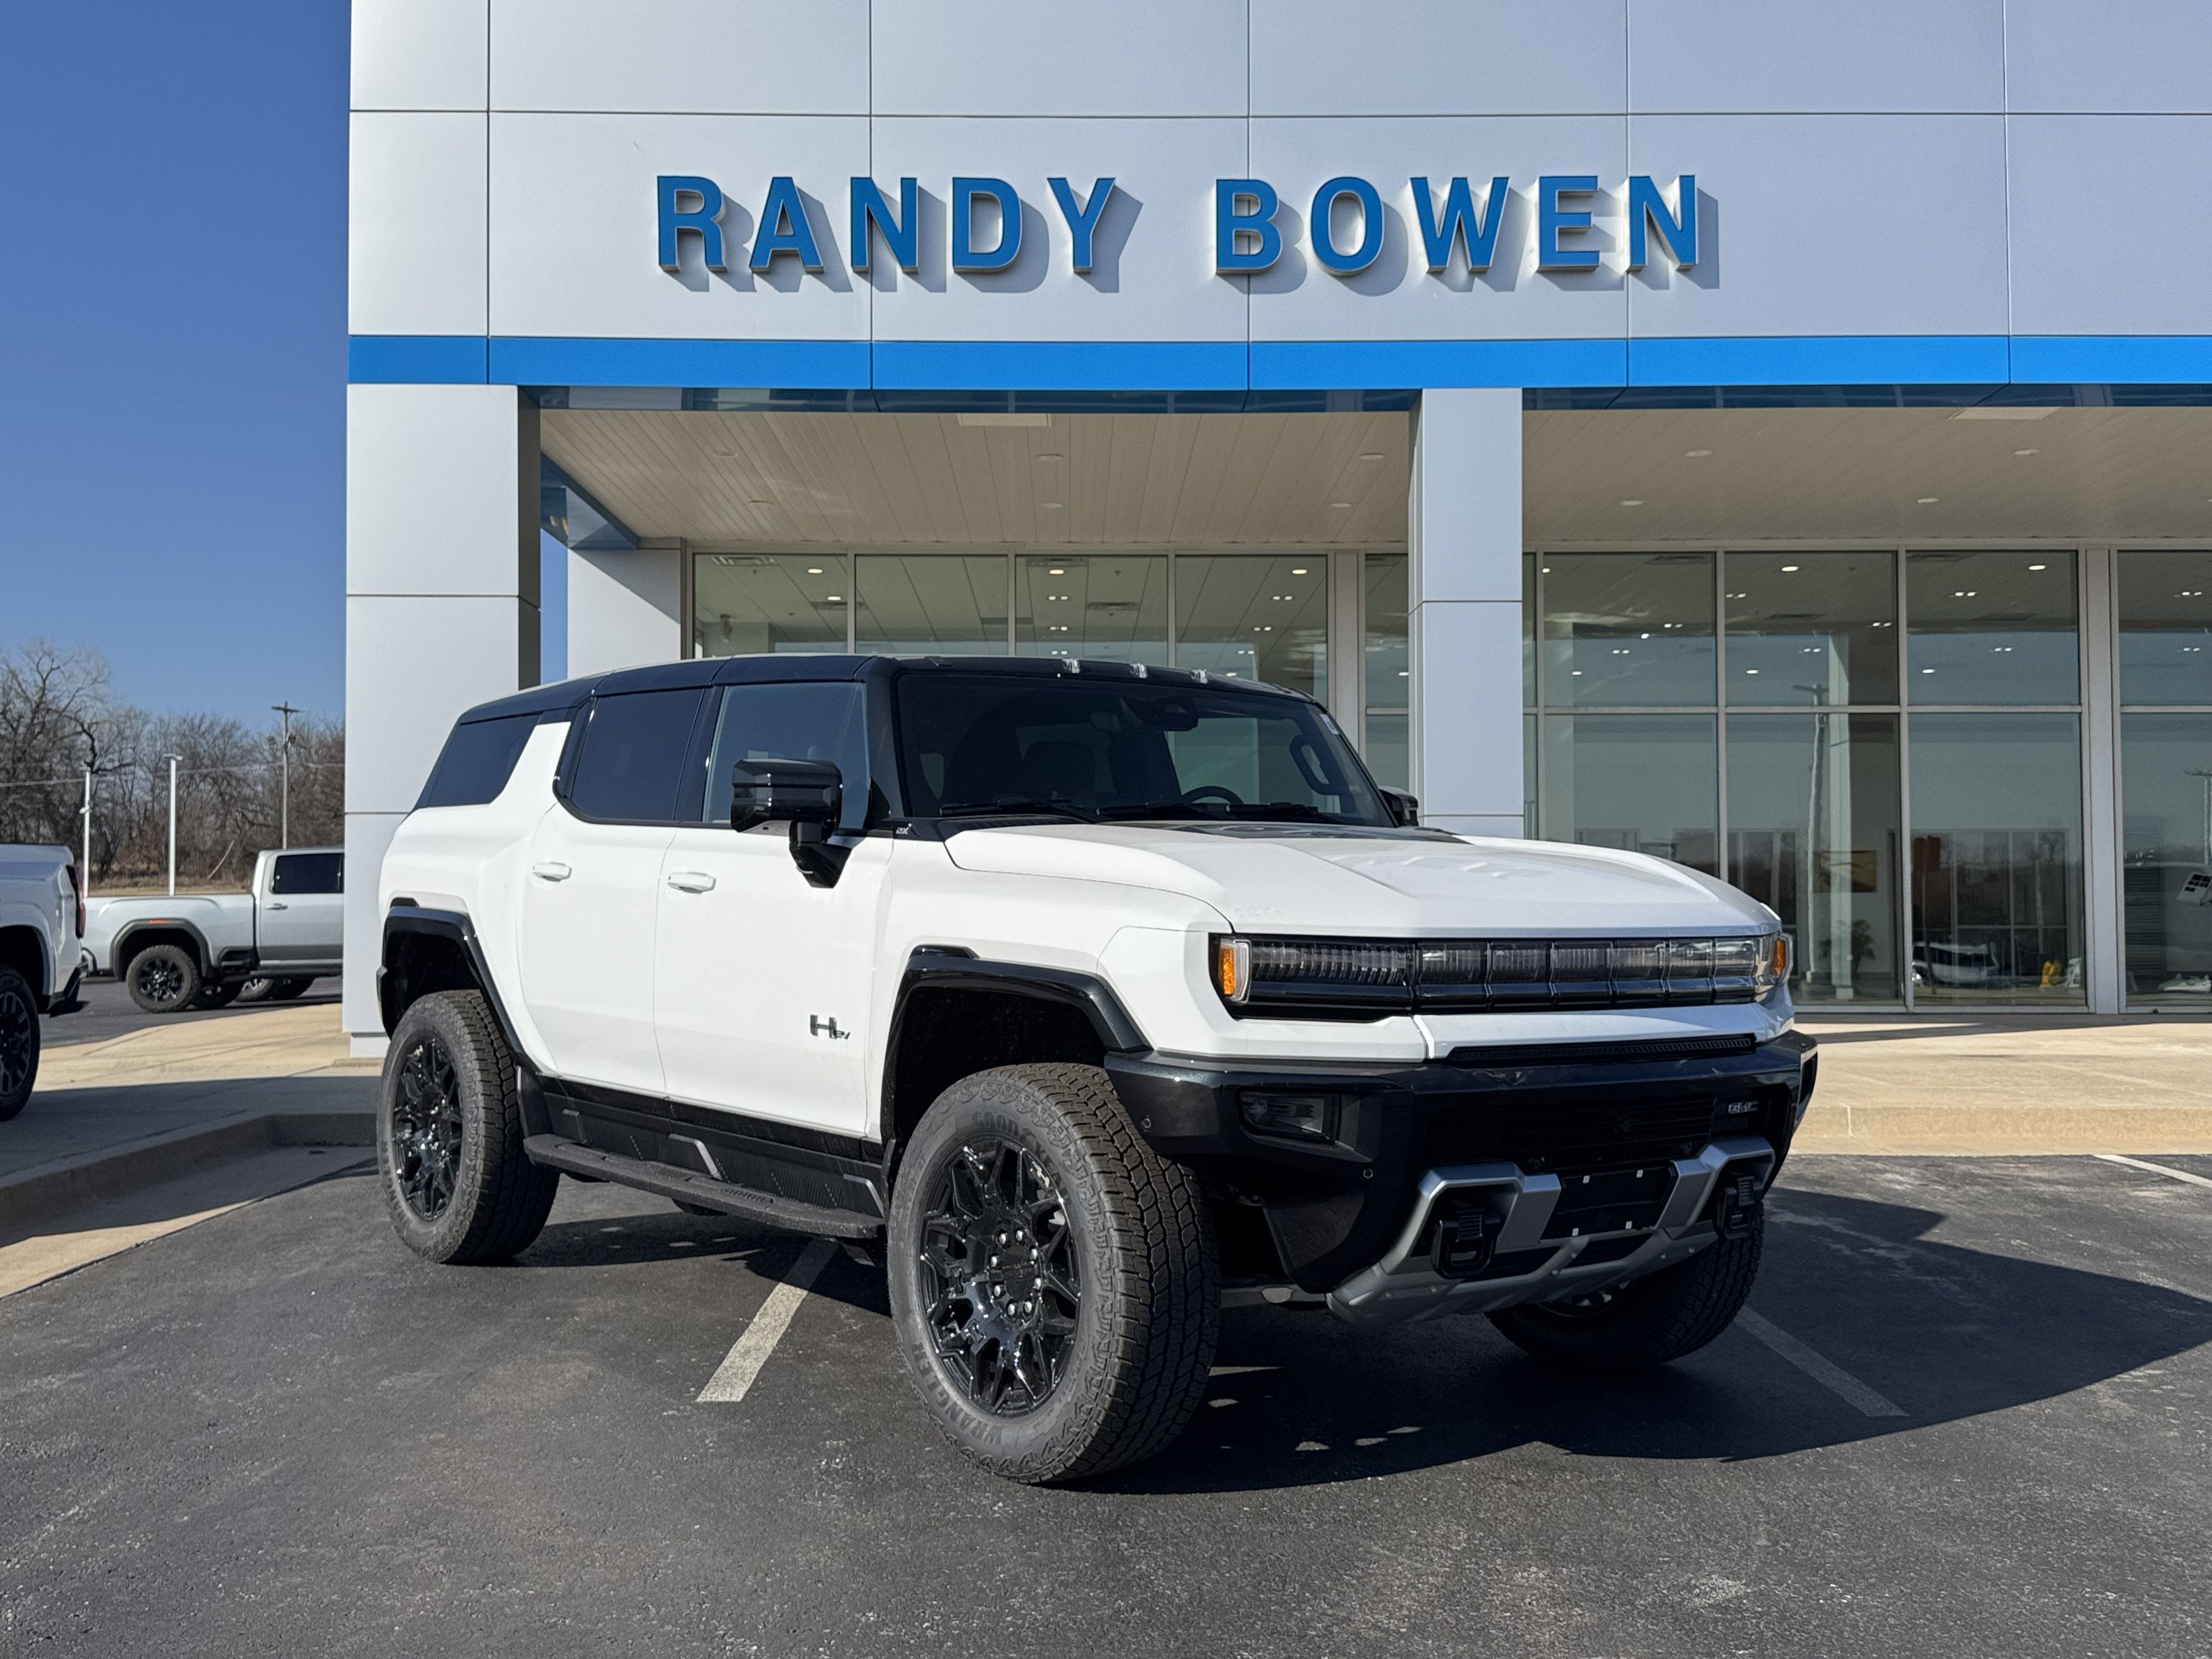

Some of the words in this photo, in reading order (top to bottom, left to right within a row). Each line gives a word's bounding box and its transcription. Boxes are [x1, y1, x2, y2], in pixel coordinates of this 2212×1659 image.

[657, 176, 1116, 273] RANDY
[1216, 175, 1698, 274] BOWEN
[972, 1110, 1069, 1198] GOODYEAR
[1728, 1101, 1758, 1114] GMC
[911, 1342, 1003, 1445] WRANGLER
